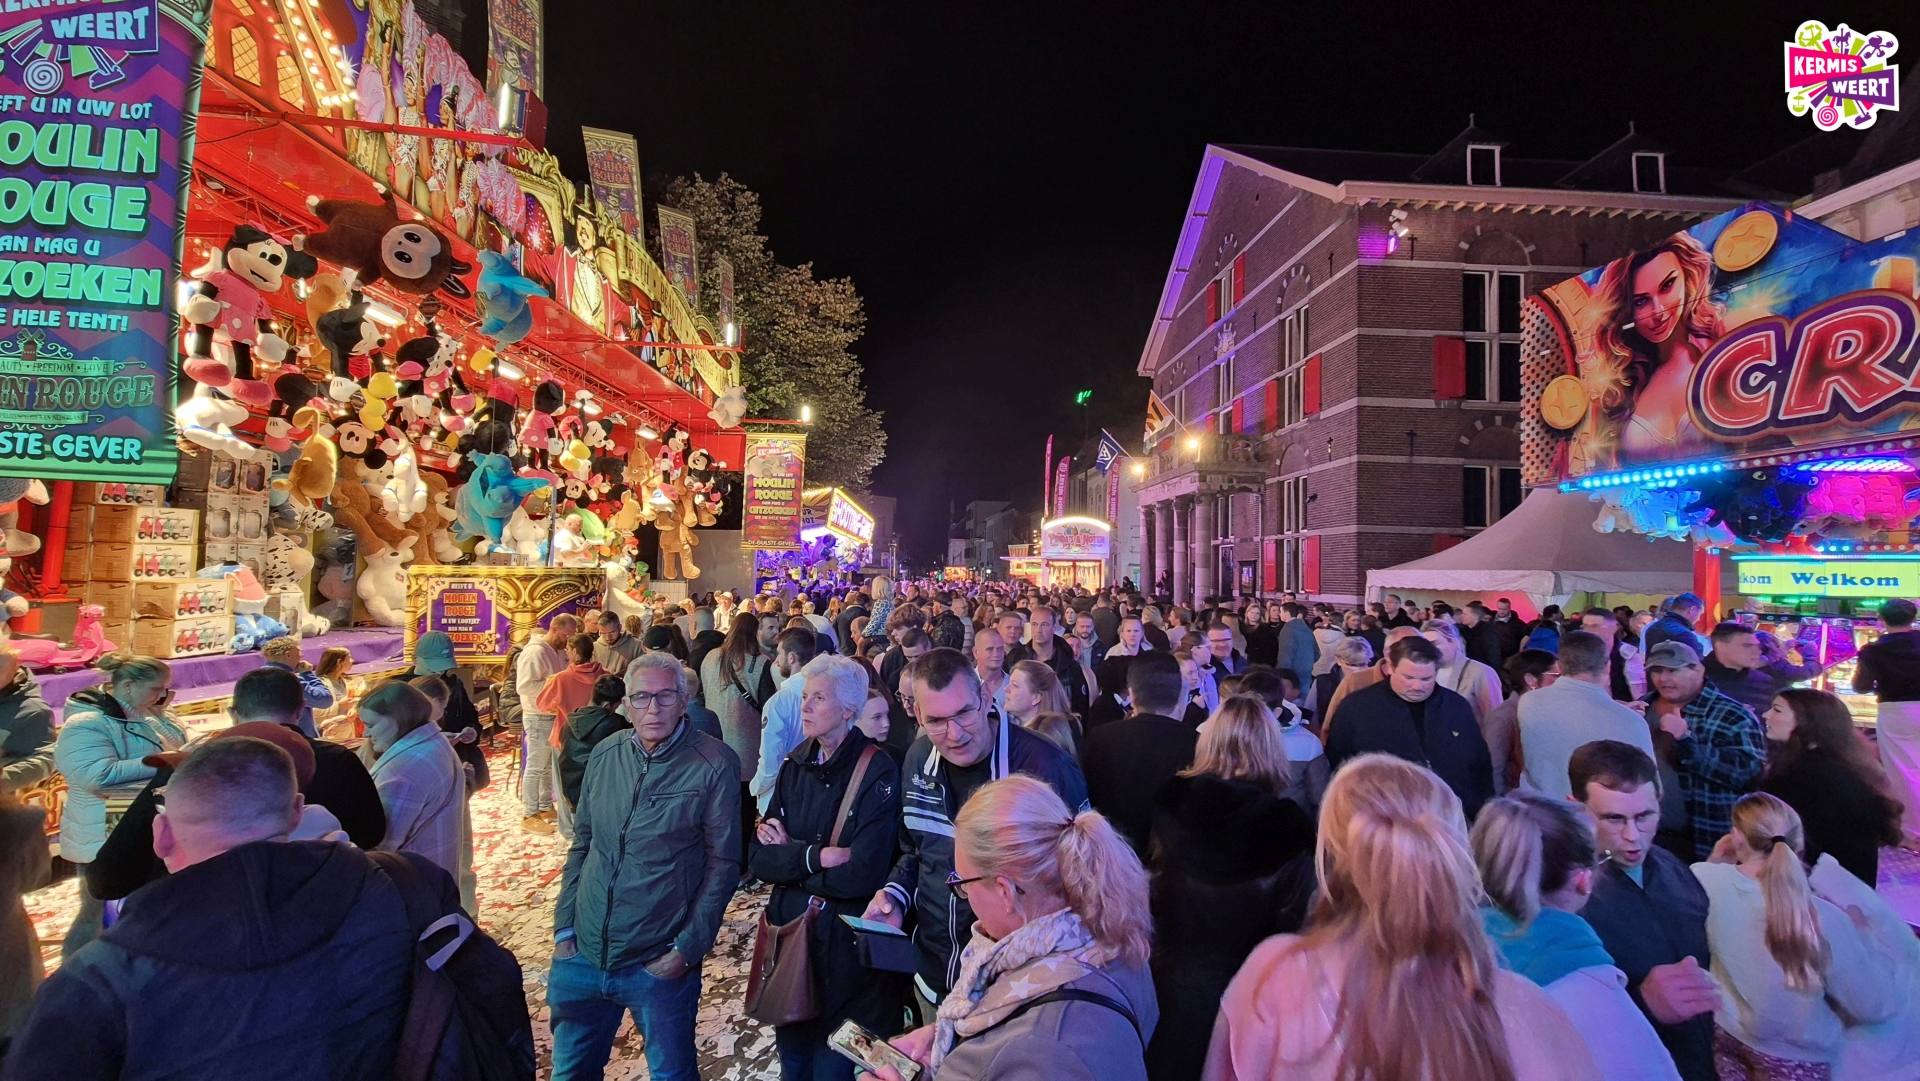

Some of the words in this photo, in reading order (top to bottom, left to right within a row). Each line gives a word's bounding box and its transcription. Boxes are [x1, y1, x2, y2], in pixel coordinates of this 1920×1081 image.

[51, 6, 150, 40] WEERT
[30, 97, 46, 113] U
[52, 98, 72, 114] IN
[77, 98, 115, 117] UW
[120, 103, 153, 119] LOT
[34, 237, 78, 254] MAG
[84, 240, 100, 256] U
[12, 309, 61, 327] HELE
[66, 311, 129, 332] TENT!
[32, 362, 74, 373] FREEDOM
[83, 362, 109, 373] LOVE
[33, 374, 156, 411] ROUGE
[52, 434, 142, 460] GEVER
[753, 477, 796, 489] MOULIN
[754, 489, 793, 501] ROUGE
[1790, 572, 1899, 587] Welkom
[443, 593, 478, 604] MOULIN
[444, 605, 476, 617] ROUGE
[447, 633, 484, 643] ZOEKEN!
